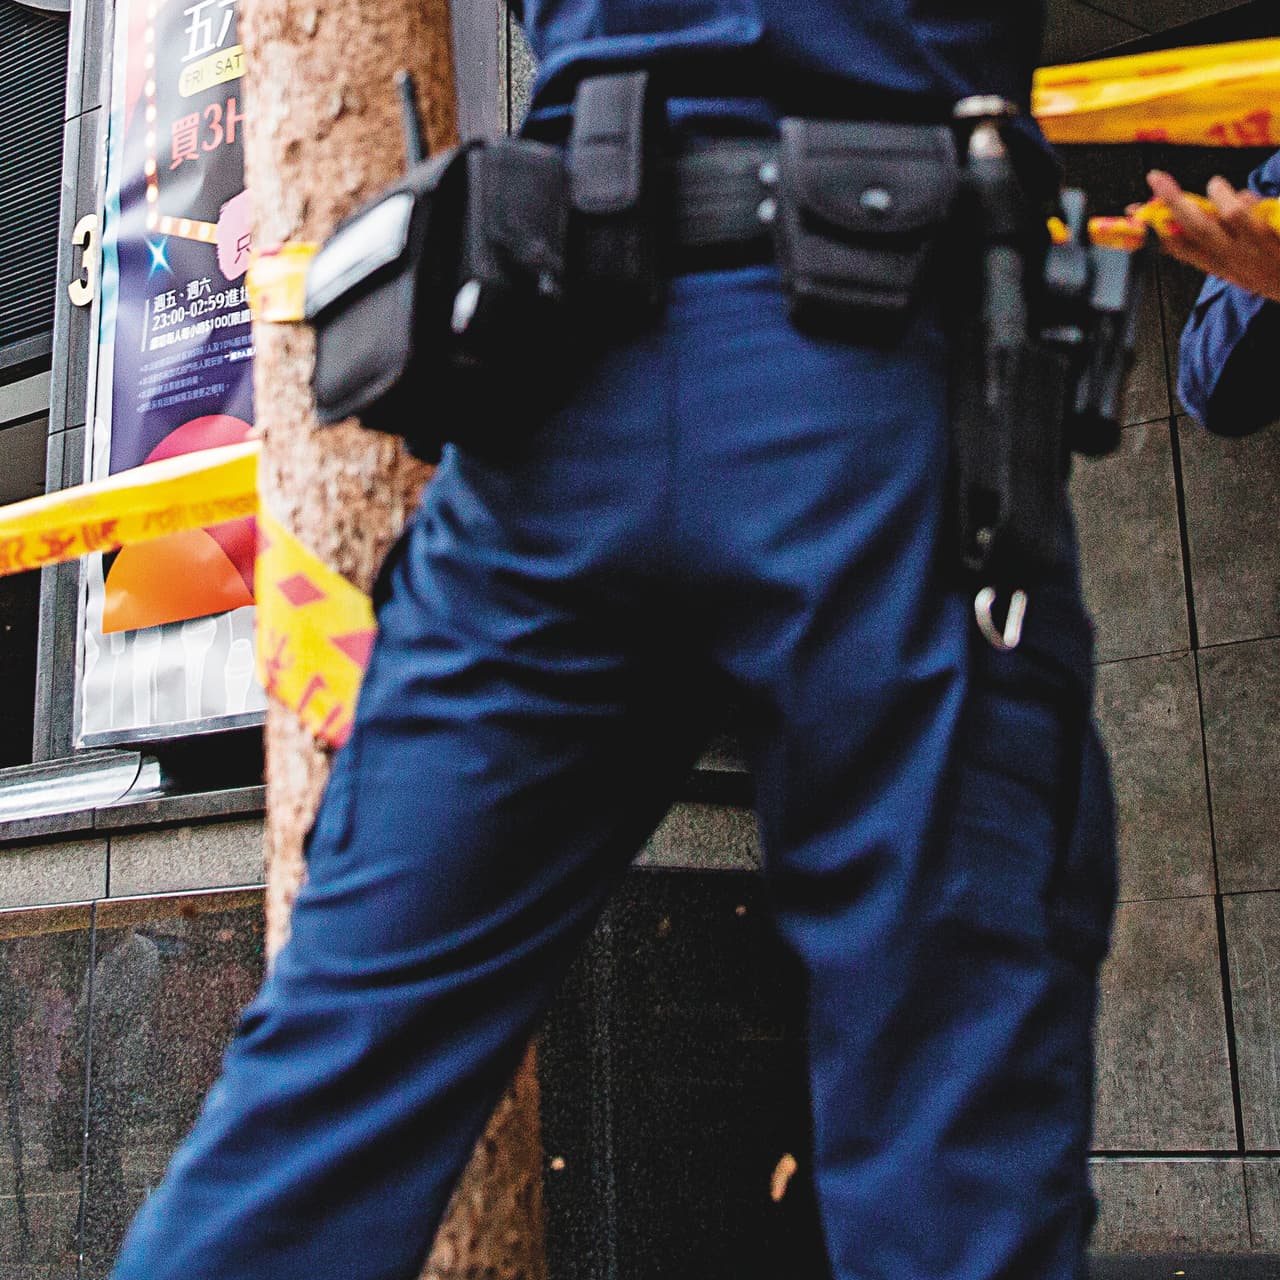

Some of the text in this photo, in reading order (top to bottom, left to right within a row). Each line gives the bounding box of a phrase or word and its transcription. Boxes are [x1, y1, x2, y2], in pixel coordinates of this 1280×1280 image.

[185, 52, 244, 86] FRI SAT
[68, 214, 97, 307] 3
